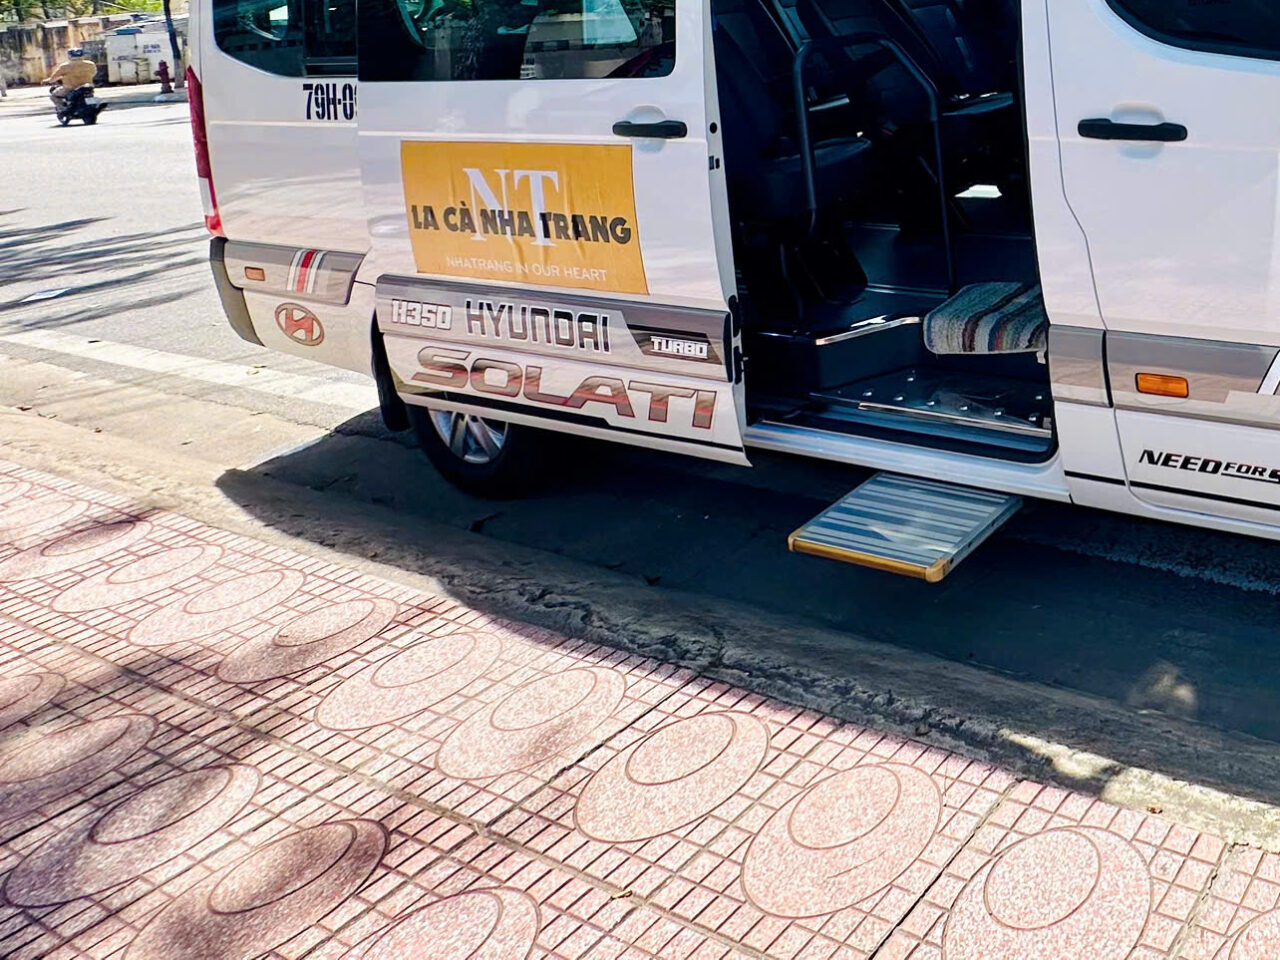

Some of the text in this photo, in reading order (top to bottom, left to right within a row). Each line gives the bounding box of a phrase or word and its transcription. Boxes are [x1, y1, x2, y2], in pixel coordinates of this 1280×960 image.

[303, 83, 358, 120] 79H-0
[411, 201, 632, 245] LA CÀ NHA TRANG
[463, 168, 559, 247] NT
[447, 257, 607, 281] NHATRANG IN OUR HEART
[391, 298, 709, 359] H350 HYUNDAI TURBO
[411, 345, 717, 430] SOLATI
